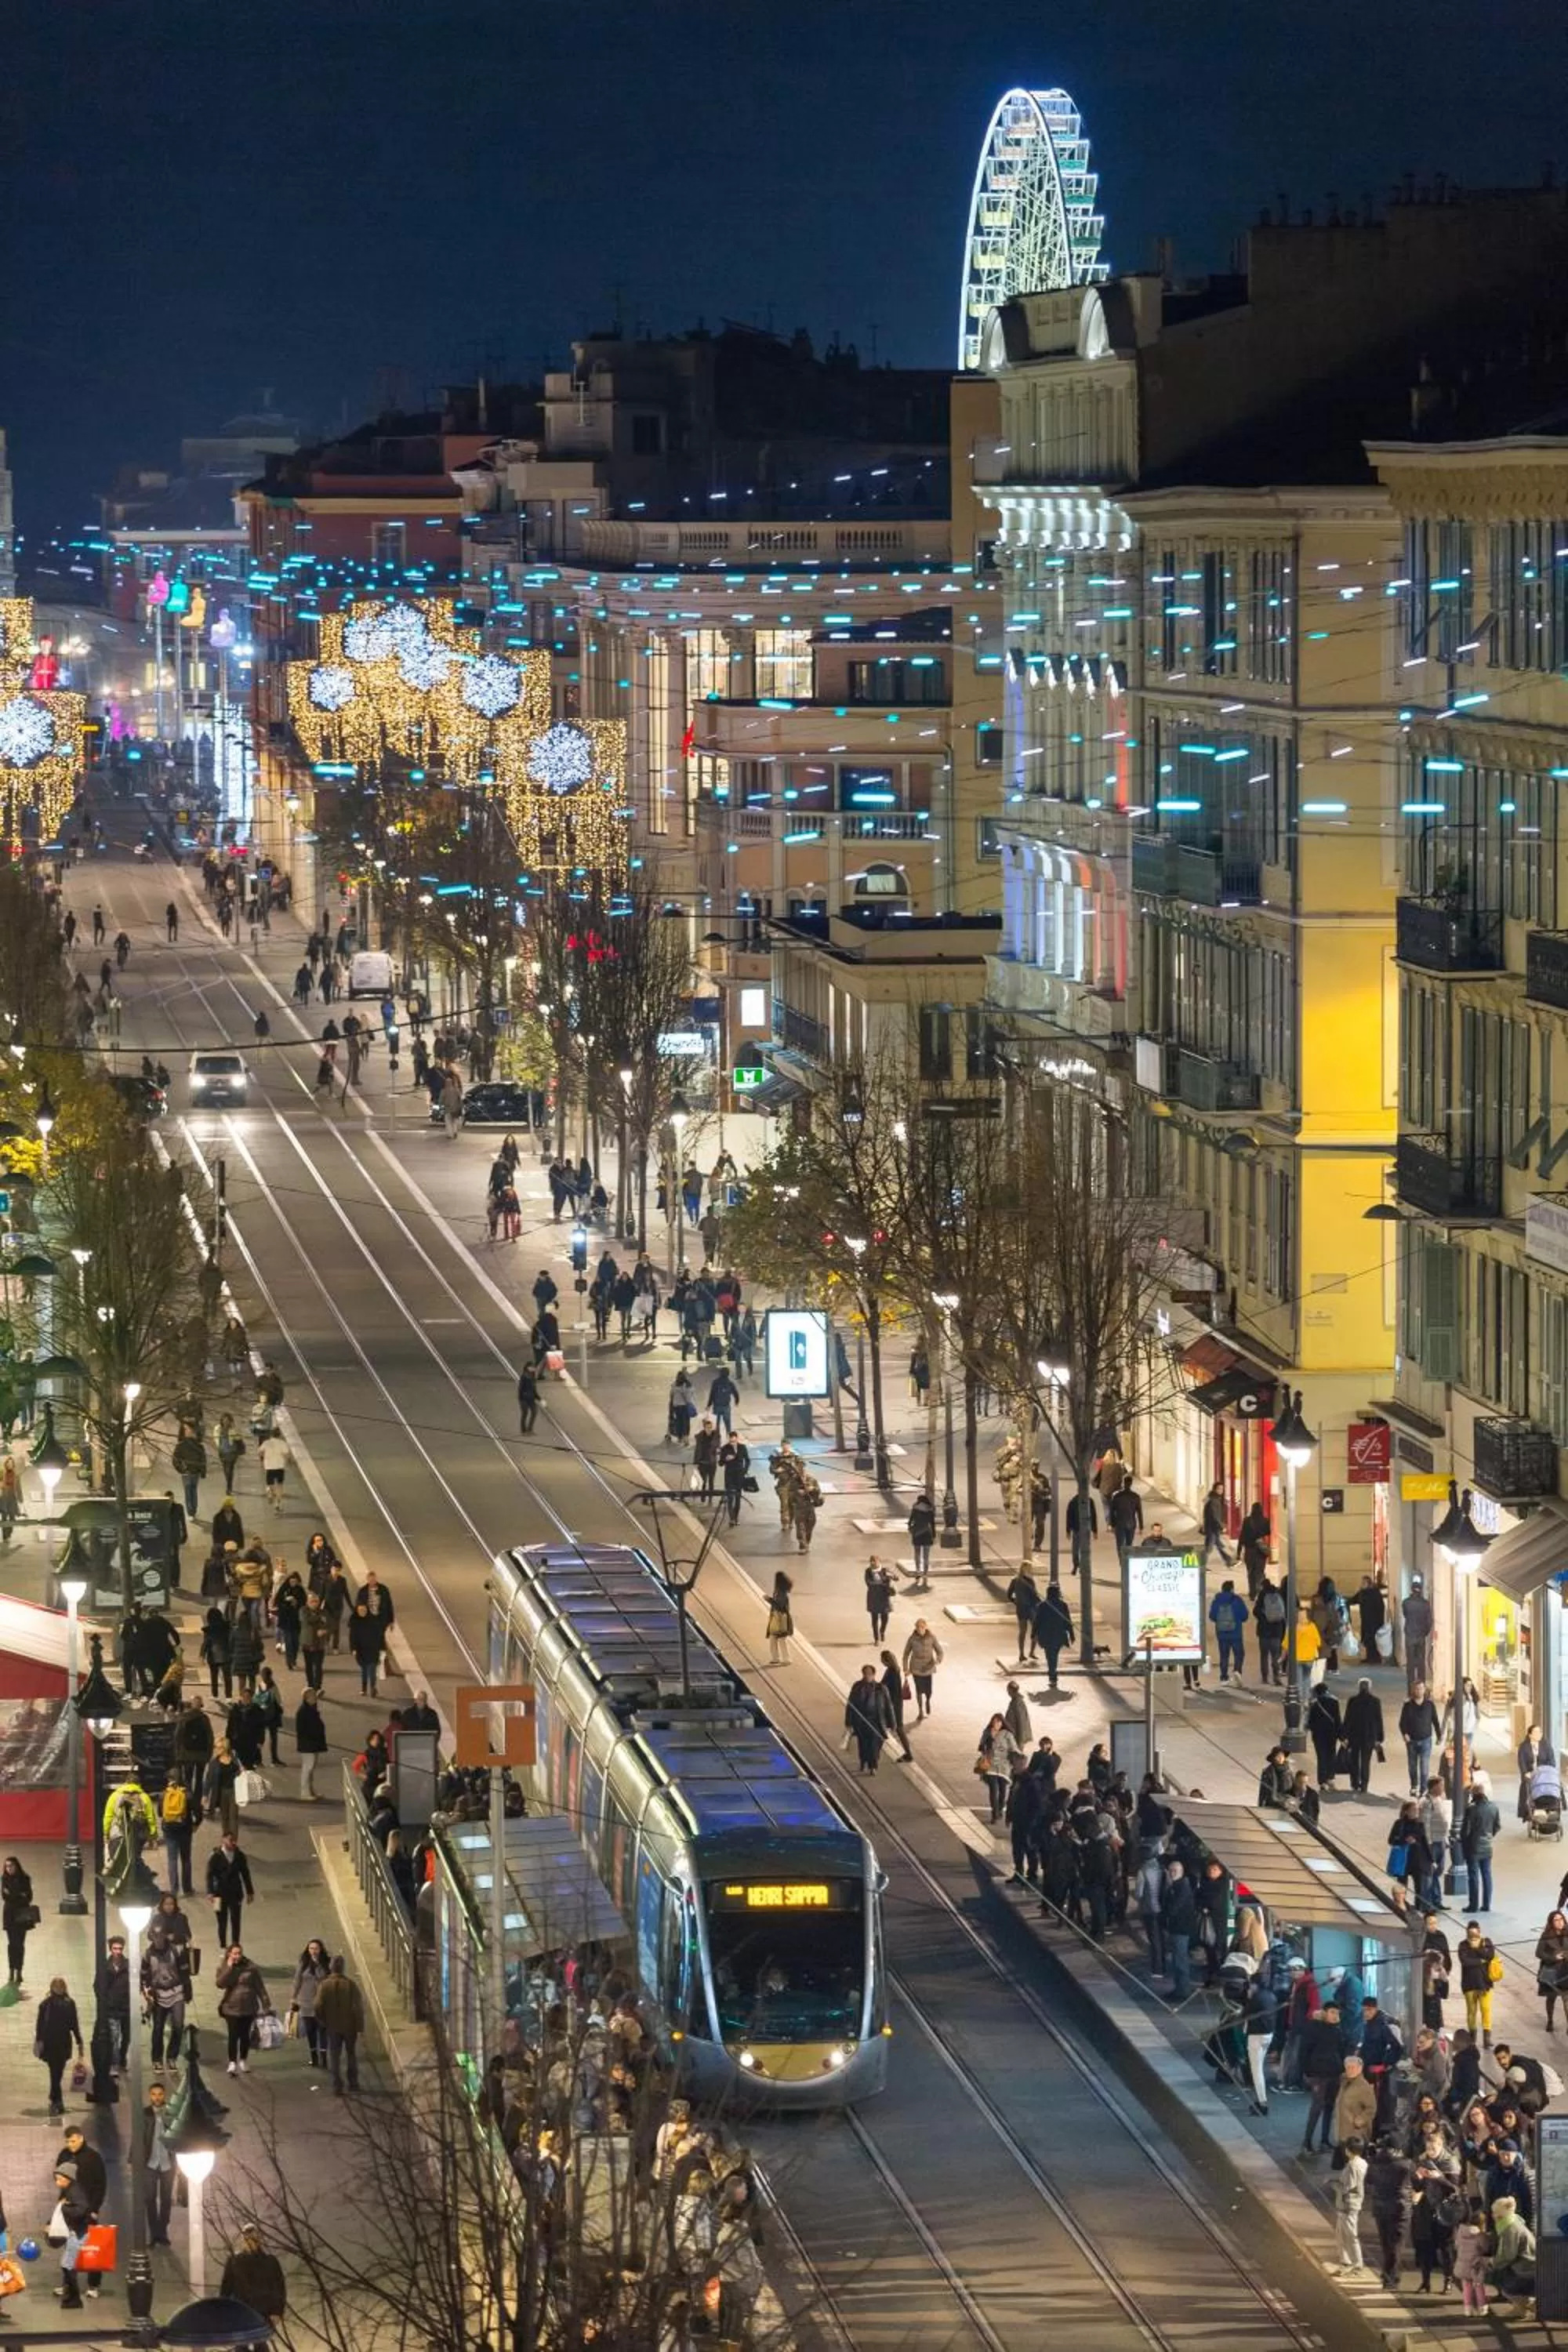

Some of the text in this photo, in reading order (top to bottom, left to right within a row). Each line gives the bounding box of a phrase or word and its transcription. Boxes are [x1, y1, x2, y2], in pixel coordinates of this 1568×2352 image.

[1240, 1395, 1258, 1412] C
[1322, 1497, 1334, 1508] C
[470, 1700, 524, 1755] T
